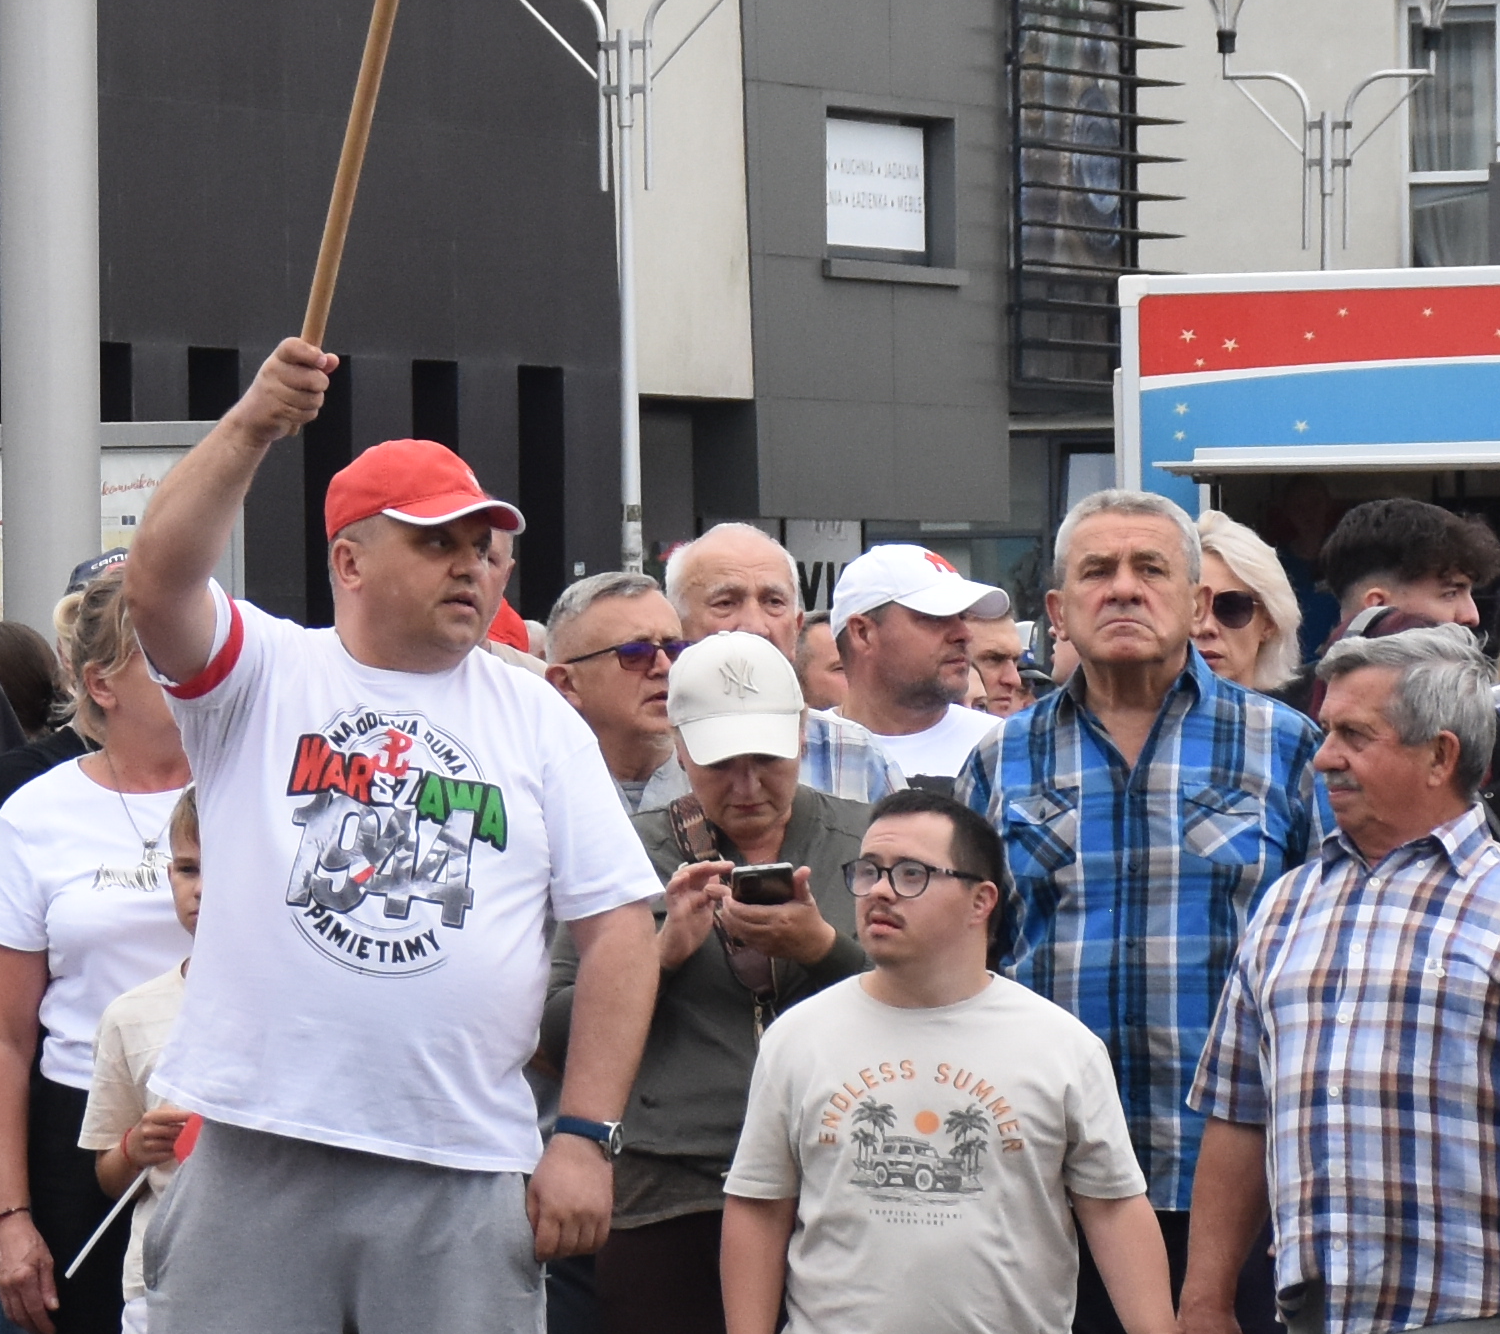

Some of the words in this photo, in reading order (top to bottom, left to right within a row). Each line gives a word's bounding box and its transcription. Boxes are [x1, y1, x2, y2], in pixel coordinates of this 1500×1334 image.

[328, 711, 420, 750] NAODWA
[287, 732, 508, 854] WARSZAWA
[286, 794, 474, 929] 1944
[818, 1059, 917, 1146] ENDLESS
[934, 1062, 1026, 1154] SUMMER
